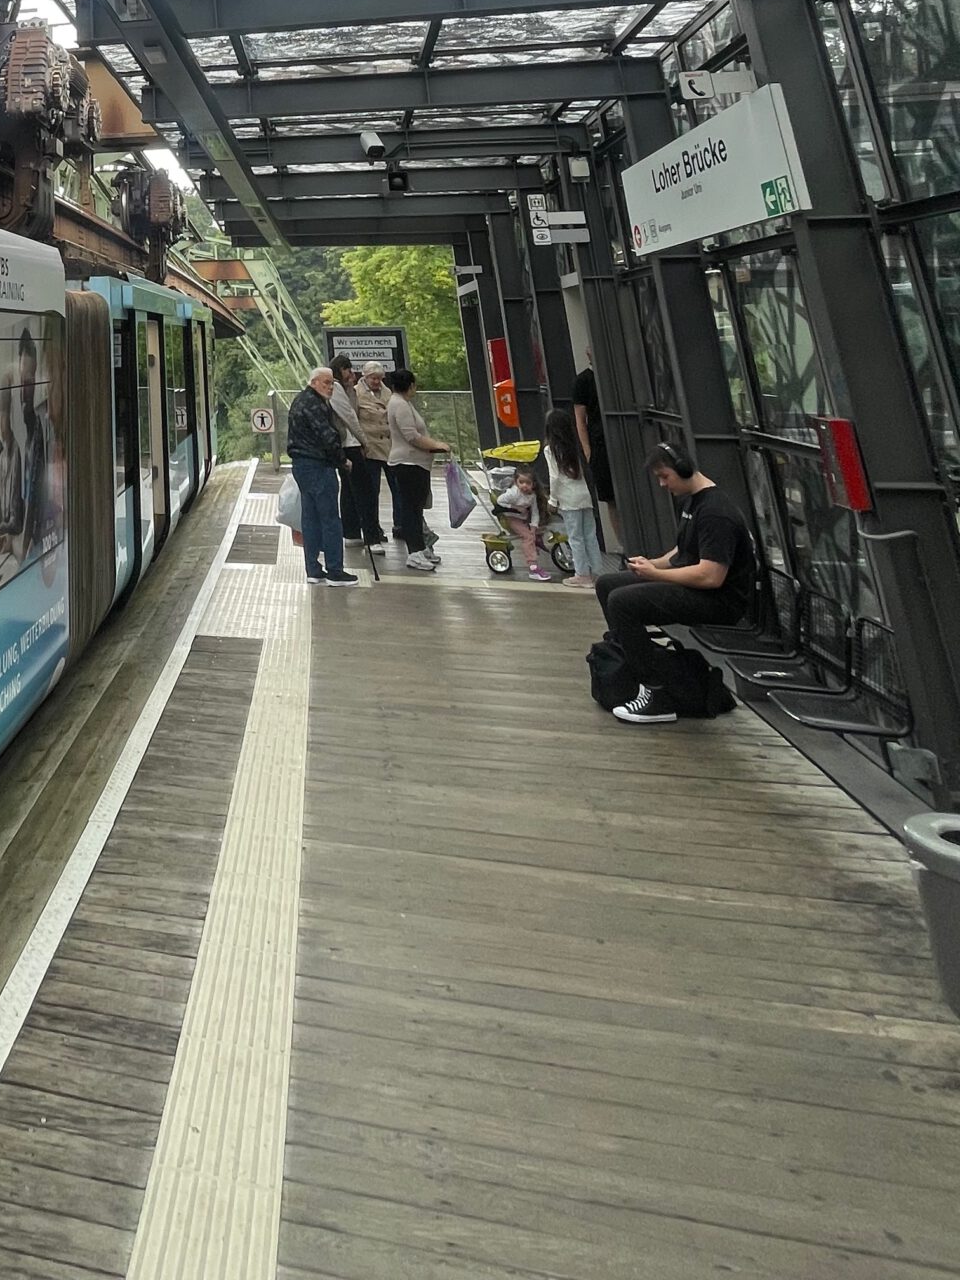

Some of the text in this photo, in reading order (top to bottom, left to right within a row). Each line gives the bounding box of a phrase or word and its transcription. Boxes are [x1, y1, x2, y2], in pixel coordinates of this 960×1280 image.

[651, 136, 728, 194] Loher Brücke
[19, 596, 65, 656] WEITERBILDUNG
